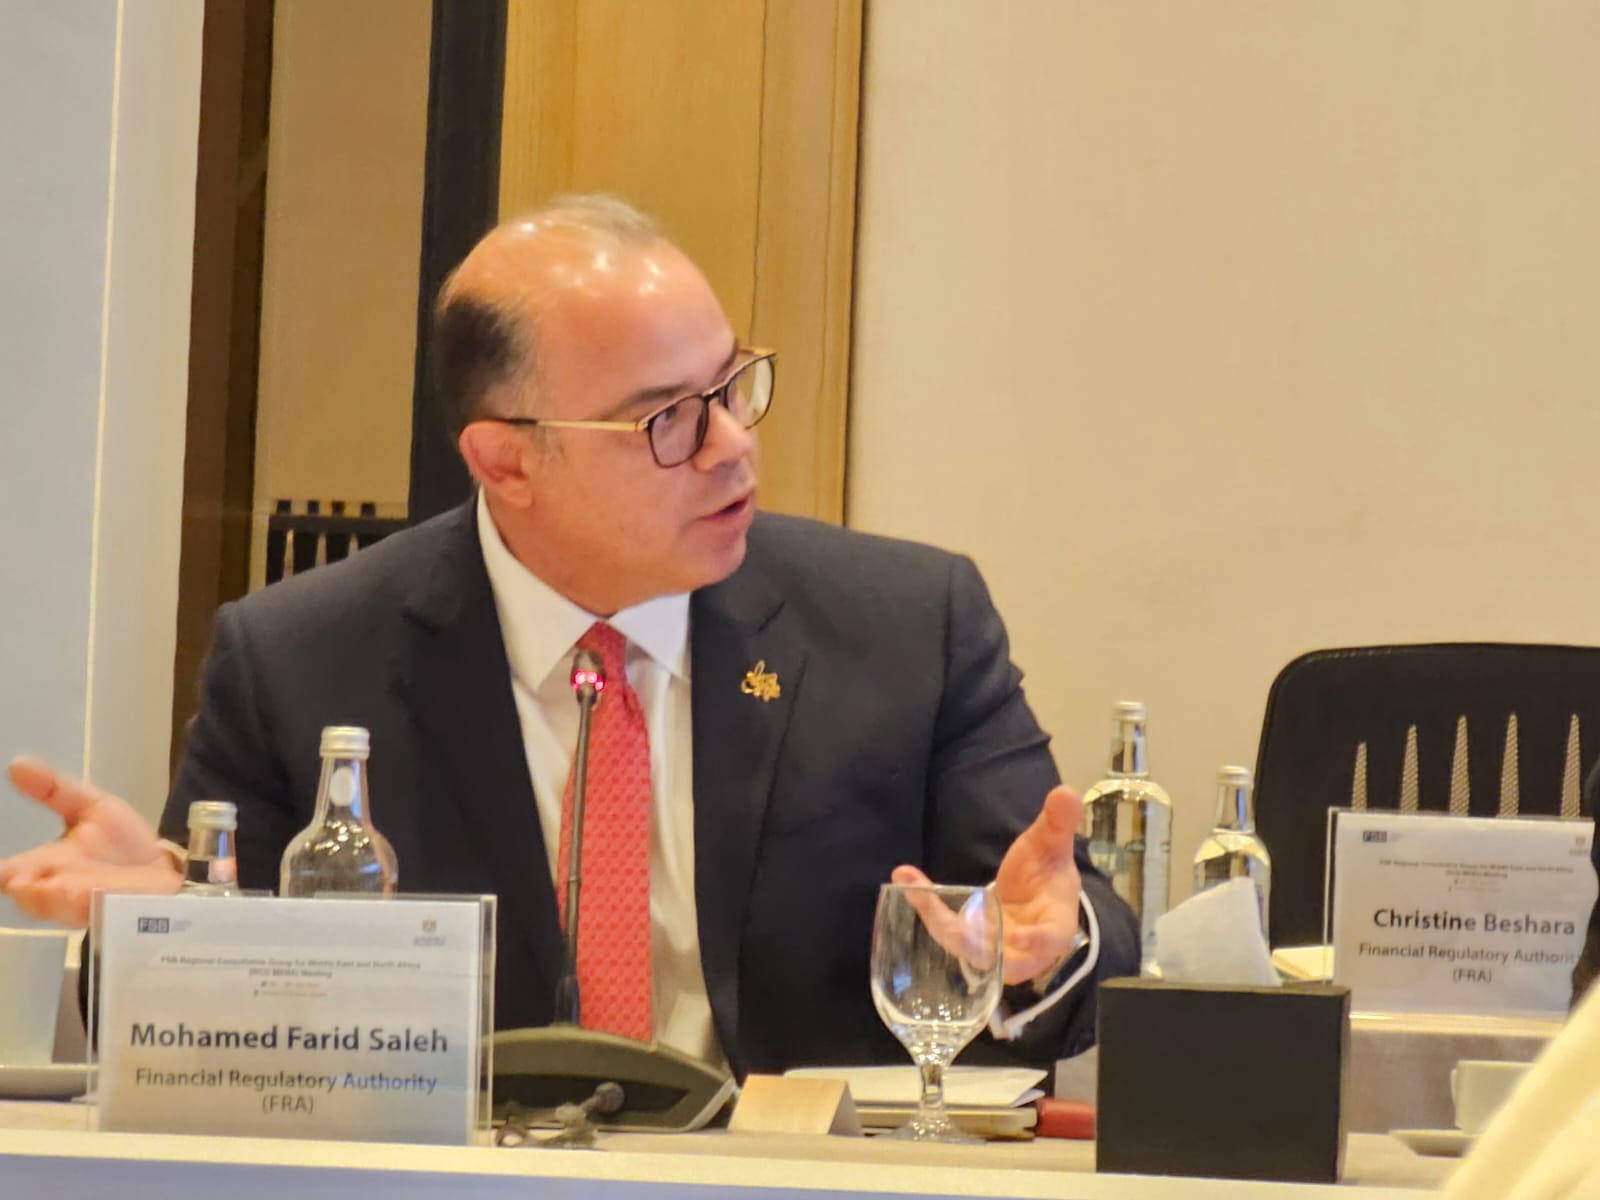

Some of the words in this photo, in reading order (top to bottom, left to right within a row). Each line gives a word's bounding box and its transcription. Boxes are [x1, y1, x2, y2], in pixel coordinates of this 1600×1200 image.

[1374, 908, 1477, 931] Christine
[1484, 913, 1575, 935] Beshara
[1359, 942, 1423, 958] Financial
[1428, 945, 1508, 963] Regulatory
[1452, 968, 1492, 984] (FRA)
[130, 1022, 277, 1049] Mohamed
[287, 1026, 359, 1050] Farid
[368, 1027, 448, 1052] Saleh
[135, 1067, 223, 1086] Financial
[229, 1069, 337, 1093] Regulatory
[343, 1072, 437, 1095] Authority
[262, 1094, 314, 1115] (FRA)
